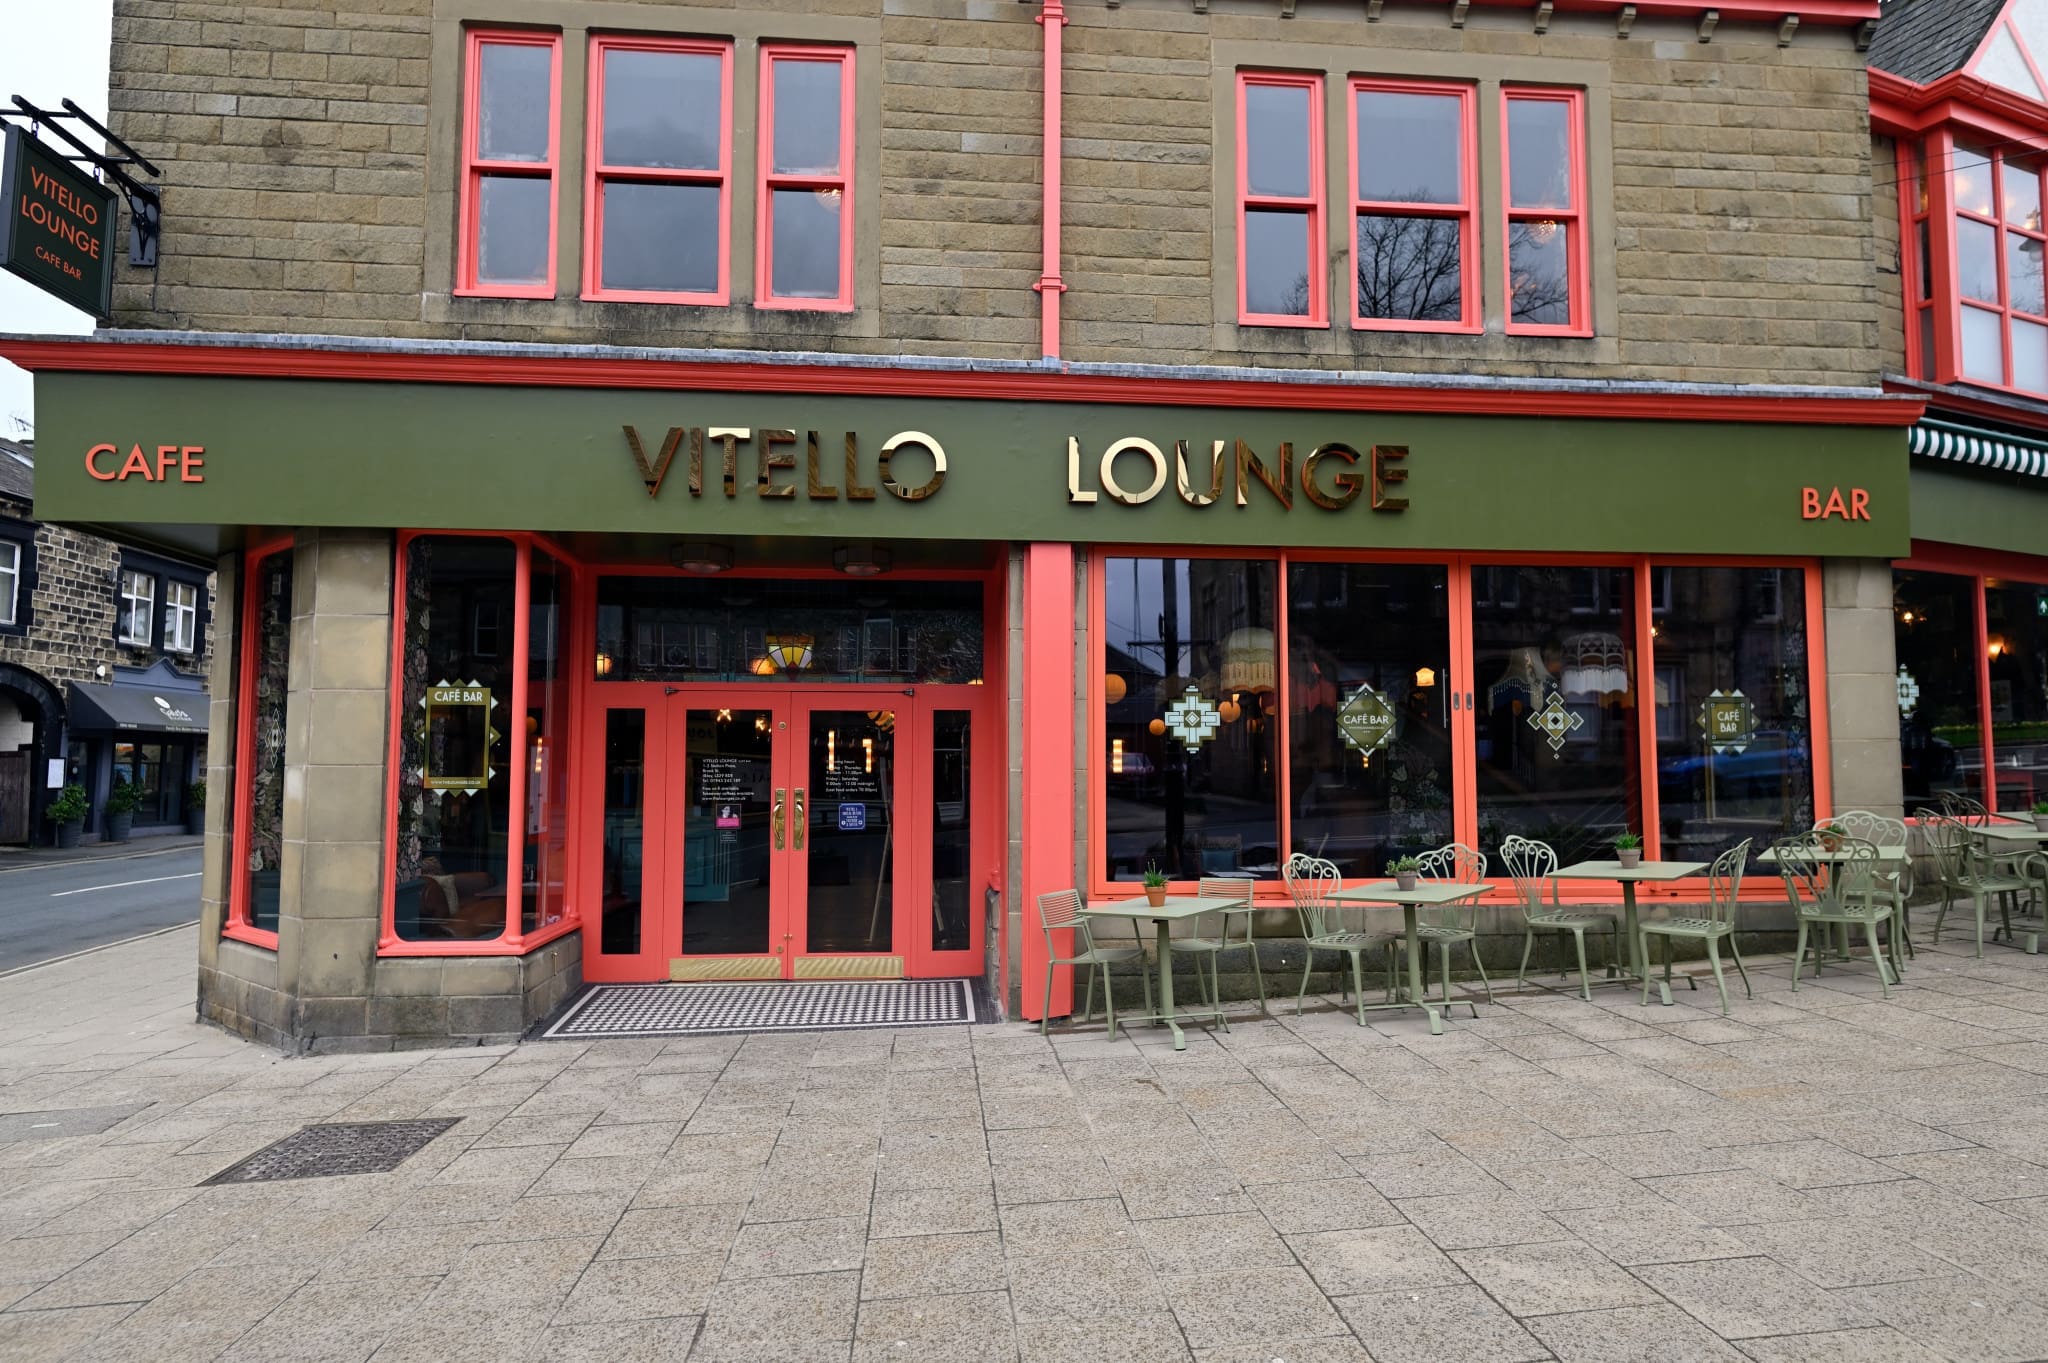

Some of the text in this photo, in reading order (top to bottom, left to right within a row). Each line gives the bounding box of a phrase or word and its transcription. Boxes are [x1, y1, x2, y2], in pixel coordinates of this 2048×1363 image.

[31, 166, 97, 225] VITELLO
[21, 195, 99, 260] LOUNGE
[63, 262, 82, 281] BAR
[84, 443, 206, 483] CAFE
[622, 425, 1410, 512] VITELLO LOUNGE
[1802, 486, 1871, 521] BAR
[434, 689, 483, 702] CAFÉ BAR
[1343, 713, 1389, 724] CAFÉ BAR
[1717, 709, 1740, 721] CAFÉ
[1719, 722, 1737, 733] BAR
